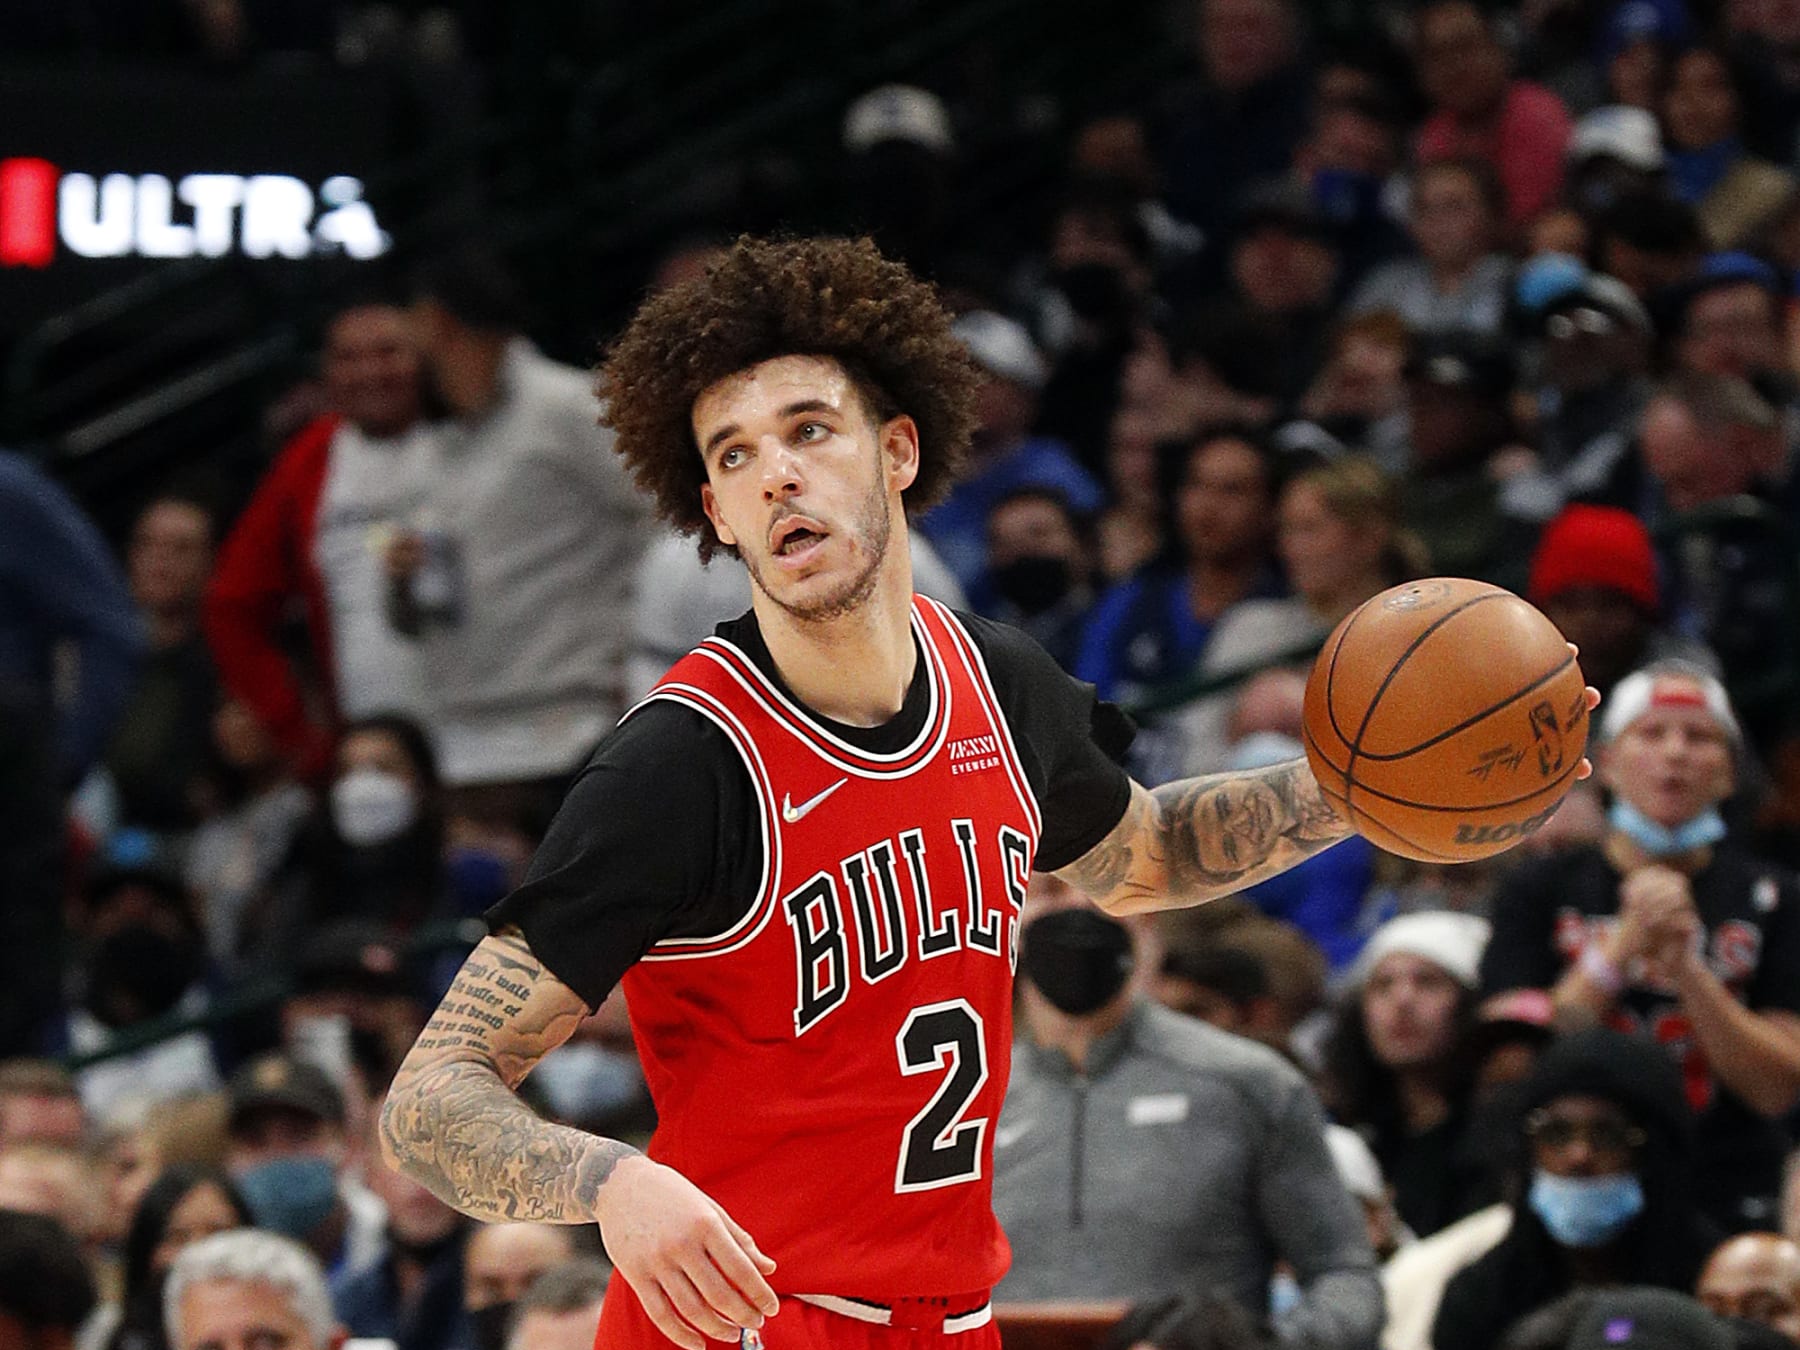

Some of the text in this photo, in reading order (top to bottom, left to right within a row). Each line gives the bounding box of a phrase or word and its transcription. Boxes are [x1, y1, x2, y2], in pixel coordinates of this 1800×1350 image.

[58, 172, 392, 260] ULTRA
[951, 756, 1000, 775] EYEWEAR
[783, 819, 1029, 1037] BULLS
[894, 998, 988, 1194] 2
[524, 1196, 564, 1221] Ball
